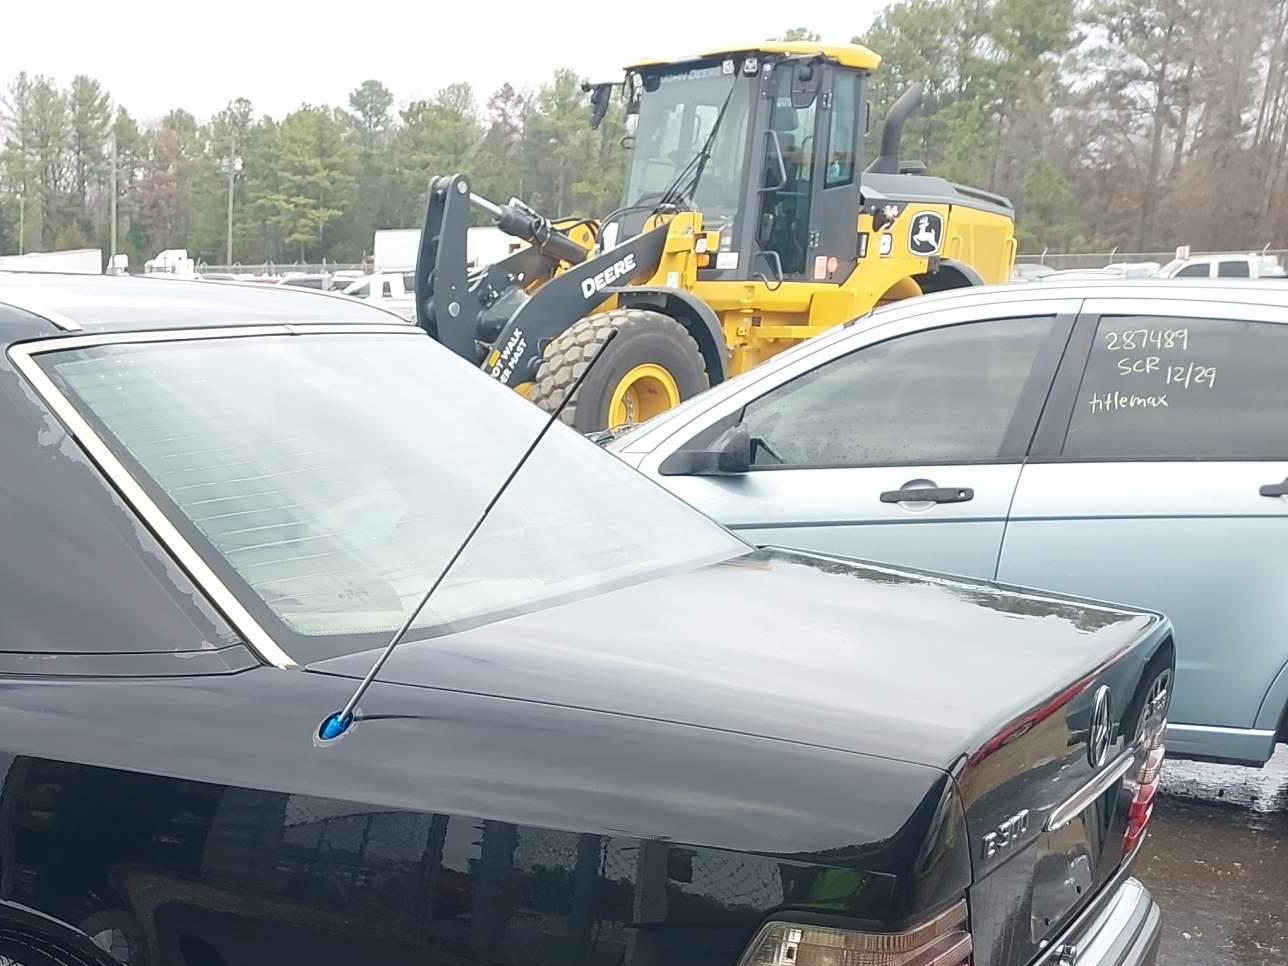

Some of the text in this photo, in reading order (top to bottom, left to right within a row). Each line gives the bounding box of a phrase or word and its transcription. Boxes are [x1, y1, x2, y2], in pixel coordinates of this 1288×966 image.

[581, 253, 637, 299] DEERE
[500, 327, 523, 360] WALK
[508, 338, 527, 369] MAST
[1105, 328, 1188, 350] 287489
[1117, 356, 1216, 388] SCR 12/29
[1088, 391, 1169, 414] titlemax
